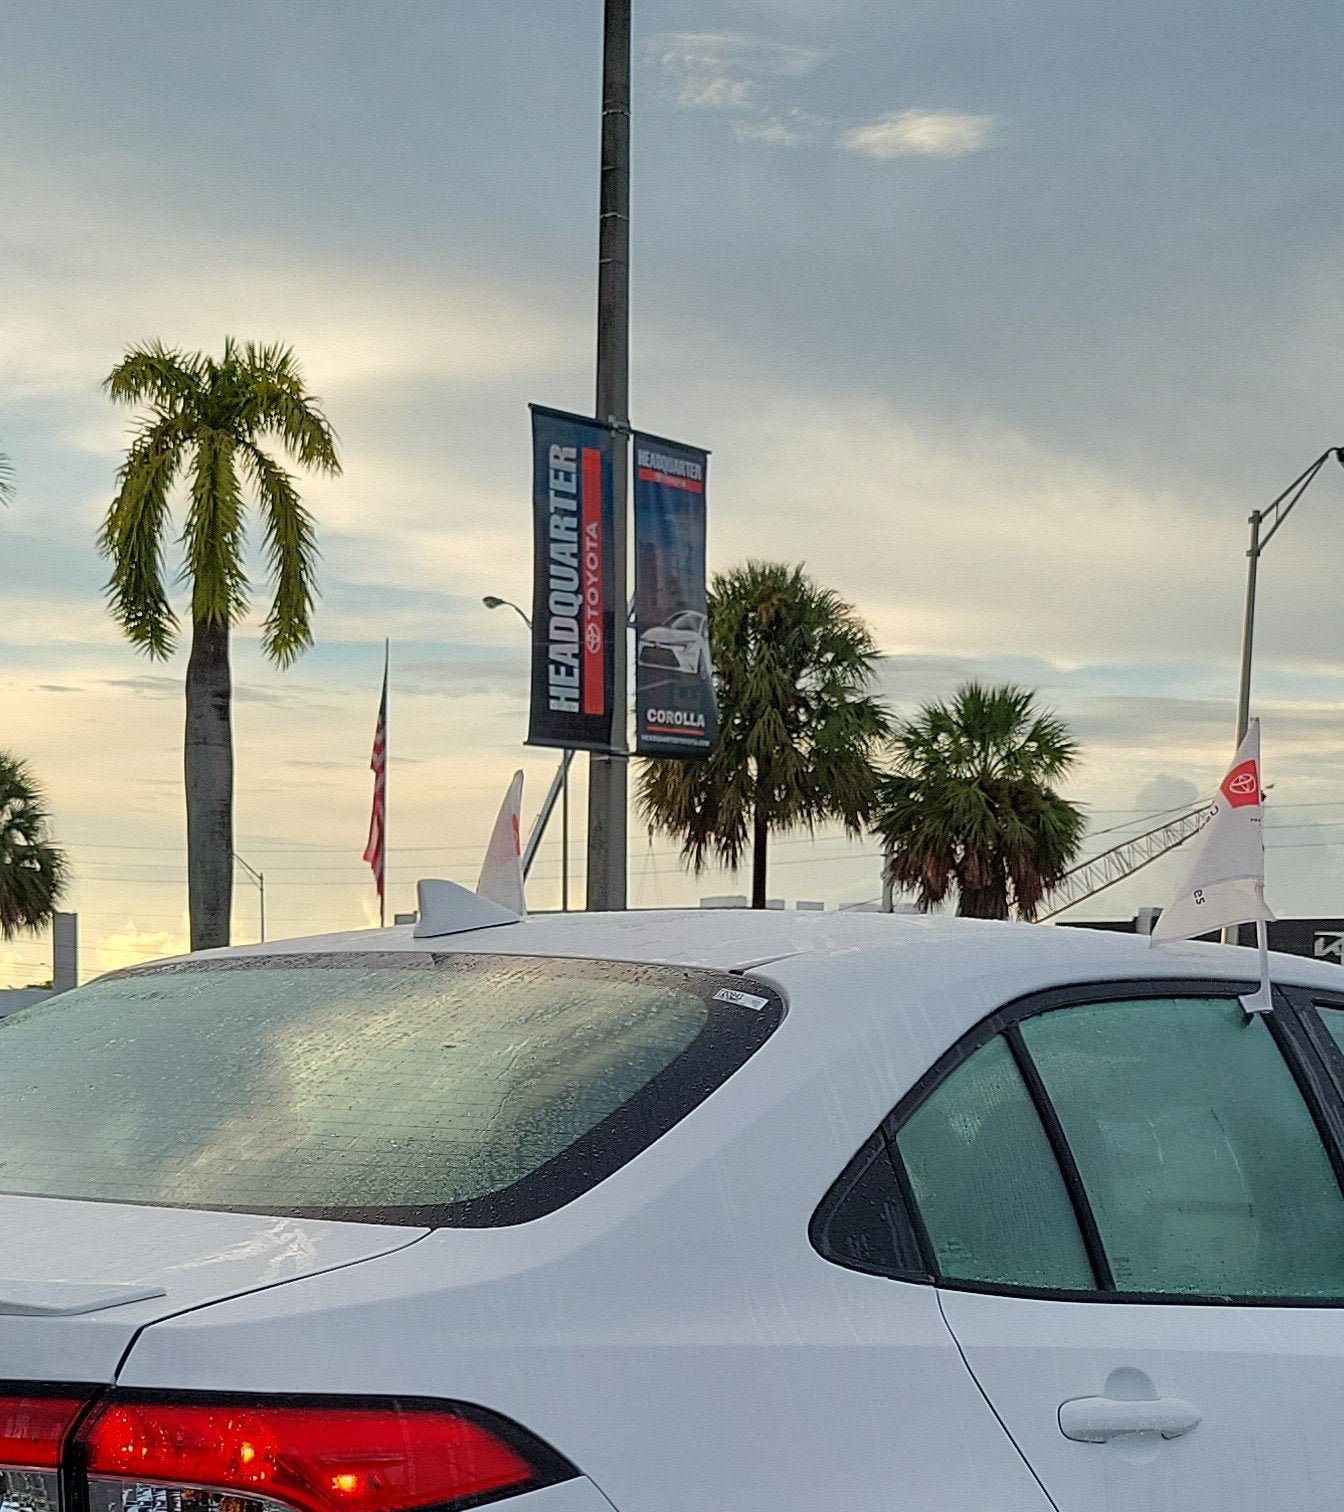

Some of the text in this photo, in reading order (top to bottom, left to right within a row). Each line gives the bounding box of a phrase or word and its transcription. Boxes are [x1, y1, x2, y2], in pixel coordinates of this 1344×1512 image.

[549, 444, 580, 713] HEADQUARTER
[585, 522, 600, 619] TOYOTA
[646, 708, 706, 728] COROLLA
